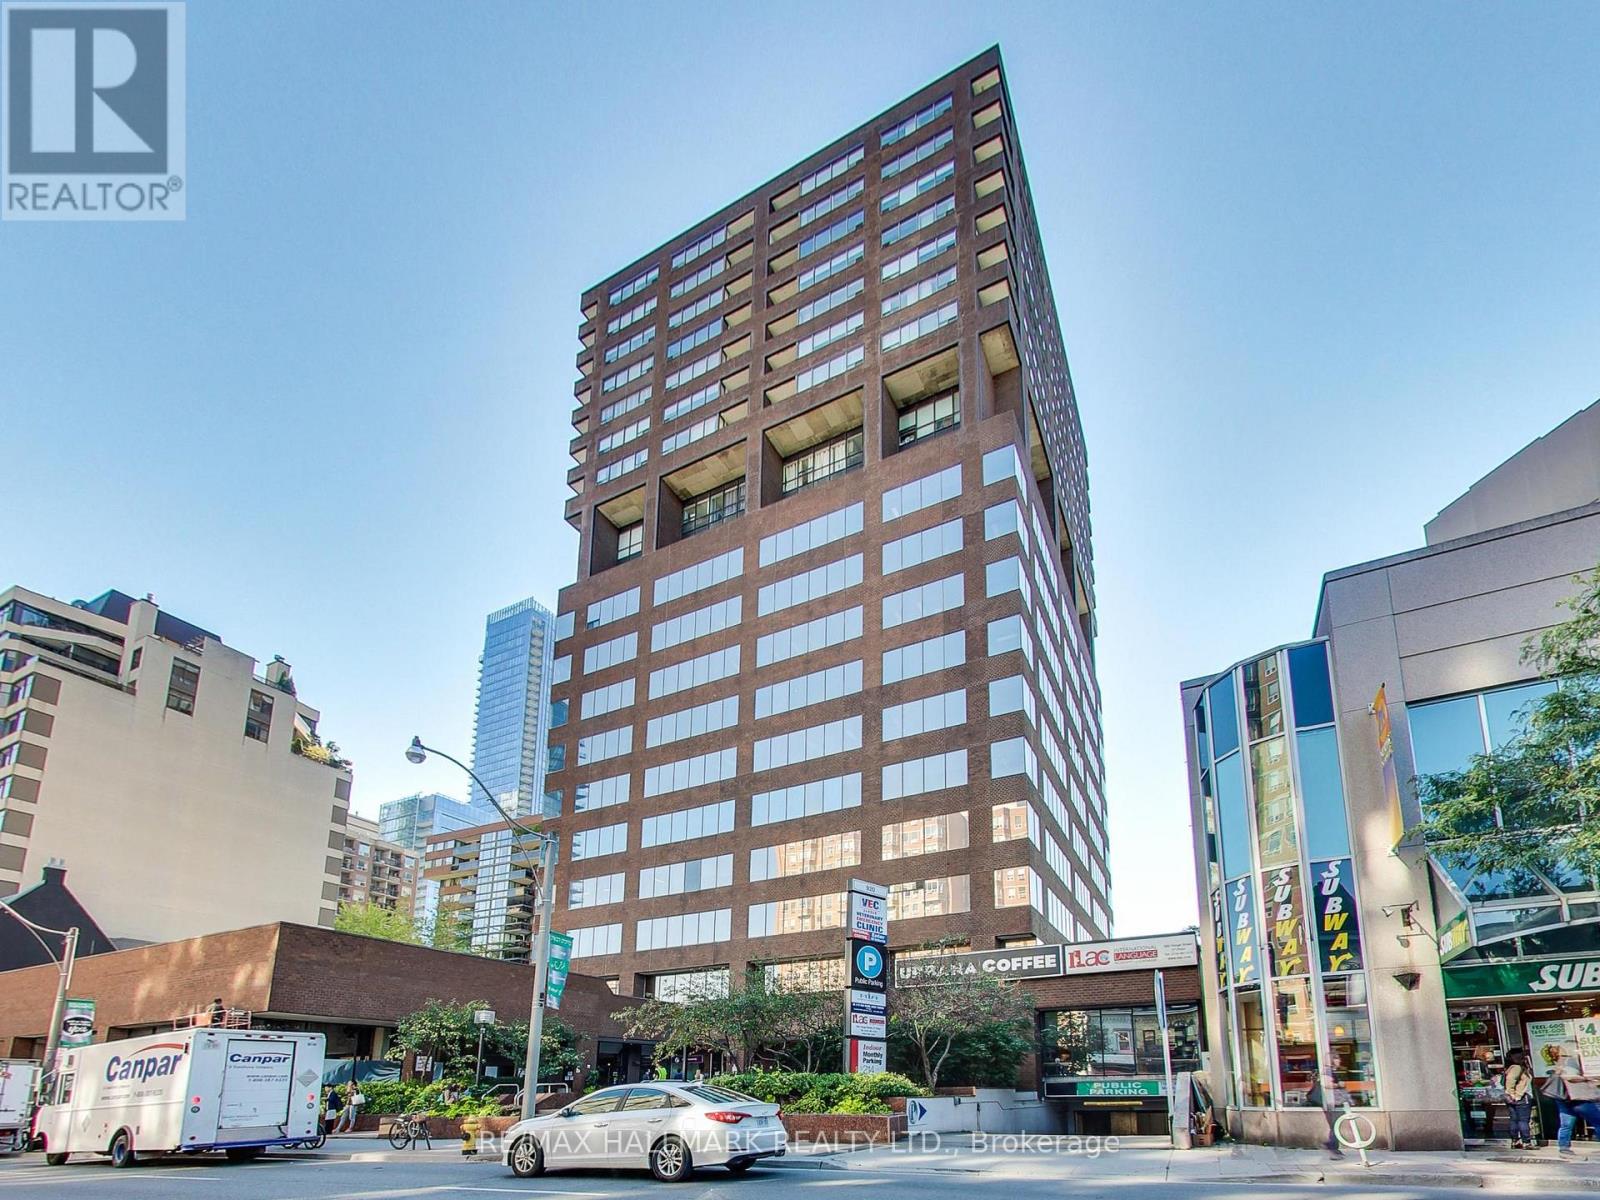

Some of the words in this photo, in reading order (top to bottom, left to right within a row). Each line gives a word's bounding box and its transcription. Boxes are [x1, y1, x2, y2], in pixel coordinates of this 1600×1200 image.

[862, 898, 879, 910] VEC
[856, 911, 883, 921] VETERINARY
[1272, 868, 1302, 976] SUBWAY
[1321, 861, 1354, 972] SUBWAY
[856, 921, 884, 934] CLINIC
[1233, 878, 1255, 984] SUBWAY
[864, 952, 877, 971] P
[1114, 950, 1158, 961] LANGUAGE
[982, 954, 1057, 973] COFFEE
[854, 976, 868, 985] Public
[868, 978, 884, 989] Parking
[1531, 1022, 1566, 1031] FEEL-GOO
[230, 1053, 291, 1065] Canpar
[863, 1051, 883, 1059] Monthly
[863, 1058, 882, 1066] Parking
[106, 1054, 183, 1084] Canpar
[1093, 1081, 1142, 1089] PUBLIC
